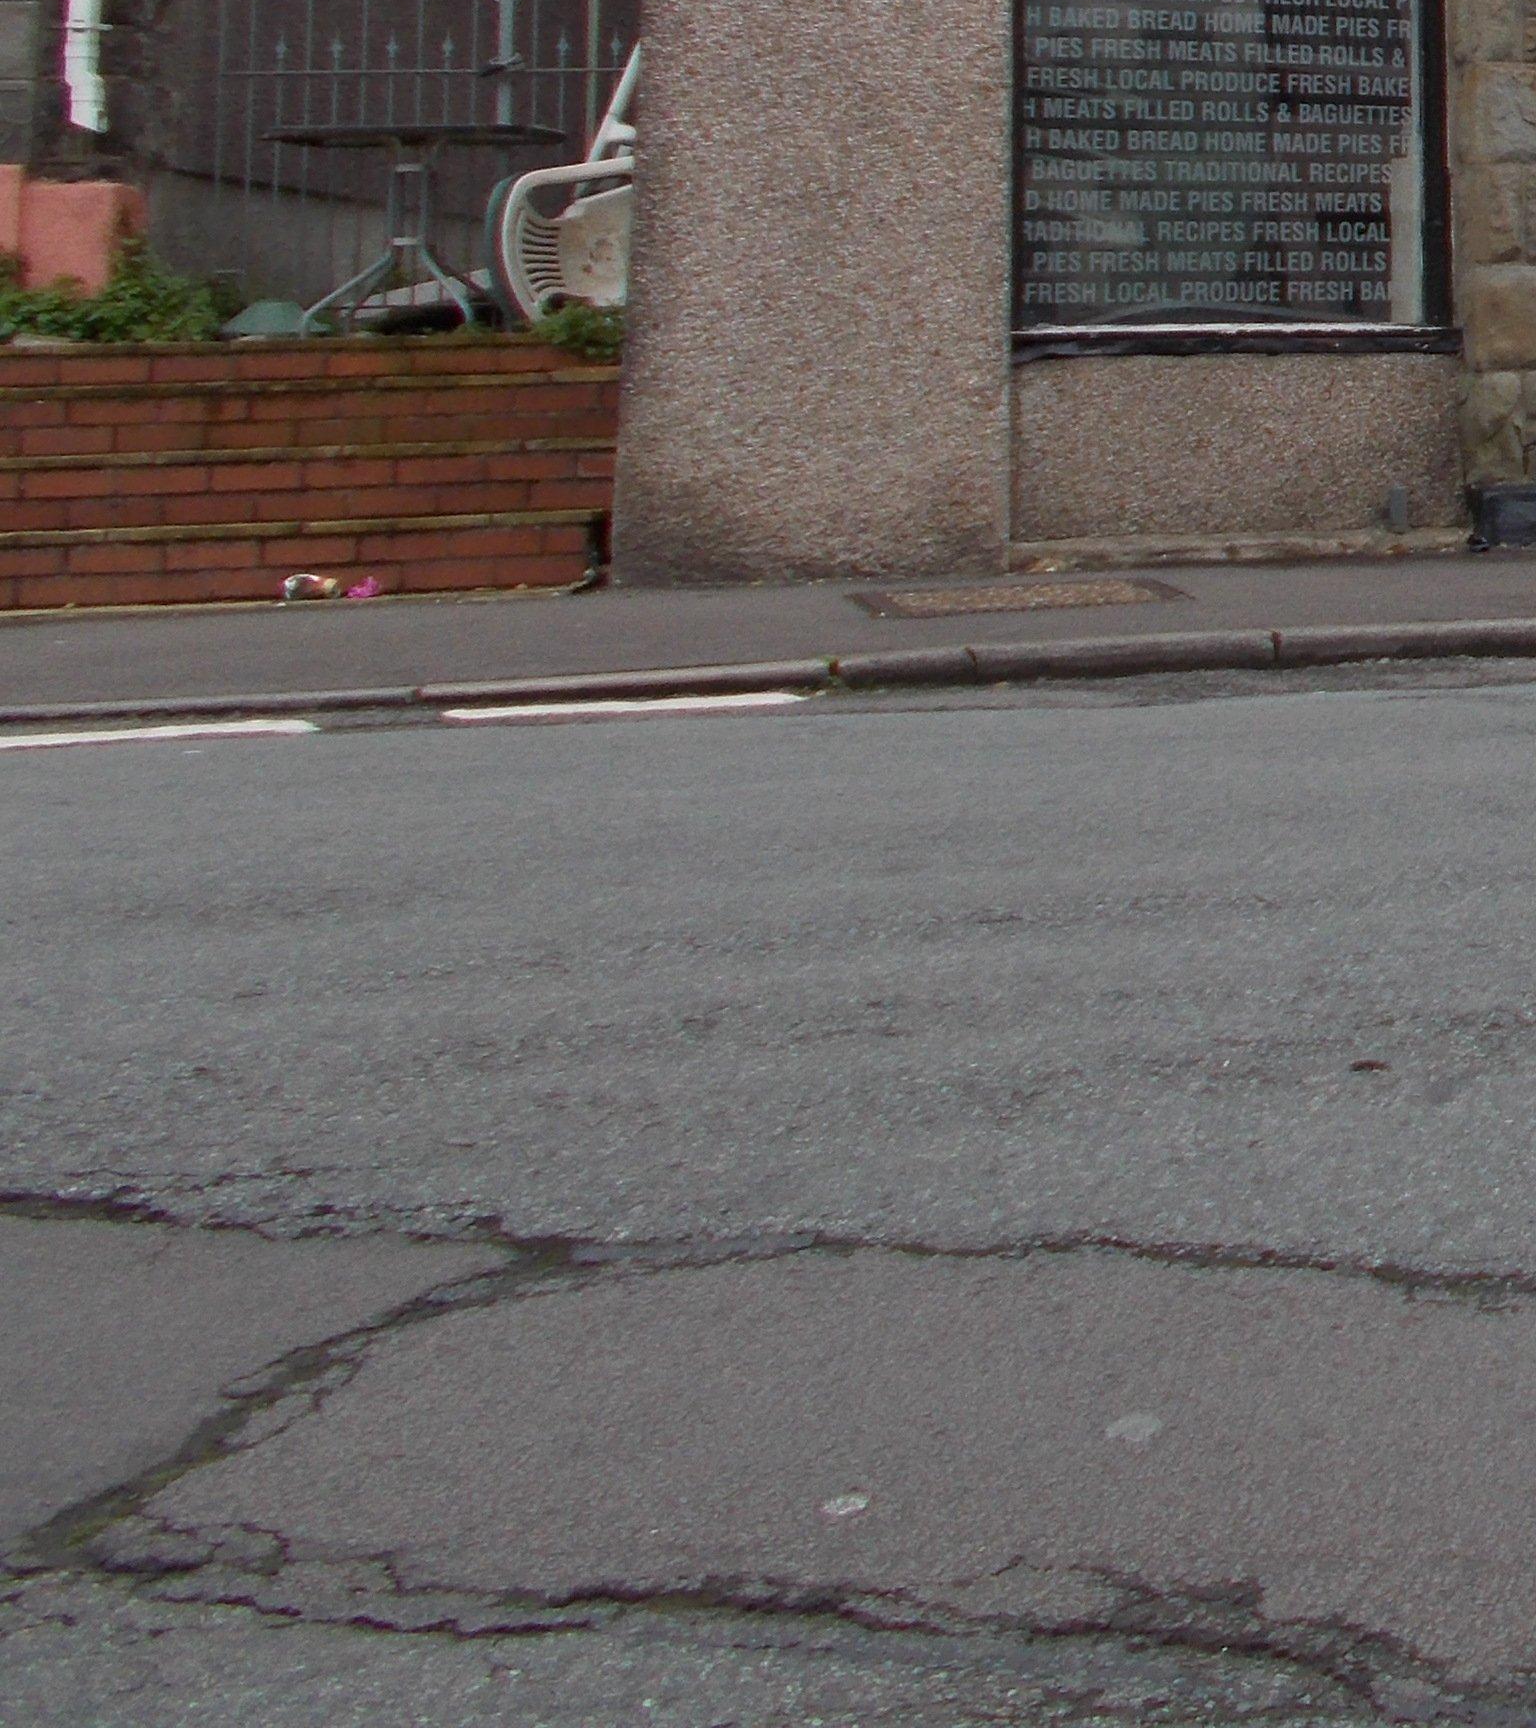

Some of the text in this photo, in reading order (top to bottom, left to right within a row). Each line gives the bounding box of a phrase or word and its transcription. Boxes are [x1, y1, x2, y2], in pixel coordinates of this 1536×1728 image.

[1050, 6, 1119, 29] BAKED
[1128, 8, 1197, 31] BREAD
[1204, 11, 1266, 34] HOME
[1271, 14, 1329, 36] MADE
[1335, 16, 1380, 39] PIES
[1035, 37, 1405, 69] PIES FRESH MEATS FILLED ROLLS &
[1026, 66, 1099, 89] FRESH
[1105, 68, 1175, 91] LOCAL
[1181, 70, 1281, 94] PRODUCE
[1287, 73, 1351, 96] FRESH
[1043, 98, 1116, 120] MEATS
[1124, 99, 1195, 121] FILLED
[1202, 100, 1269, 123] ROLLS
[1277, 102, 1291, 123] &
[1300, 103, 1413, 126] BAGUETTES
[1050, 128, 1121, 151] BAKED
[1127, 129, 1198, 152] BREAD
[1205, 131, 1267, 153] HOME
[1273, 132, 1332, 154] MADE
[1338, 133, 1383, 155] PIES
[1032, 158, 1392, 184] BAGUETTES TRADITIONAL RECIPES
[1049, 190, 1113, 212] HOME
[1119, 190, 1181, 212] MADE
[1187, 191, 1234, 212] PIES
[1241, 191, 1309, 213] FRESH
[1314, 192, 1383, 213] MEATS
[1158, 221, 1246, 243] RECIPES
[1253, 221, 1320, 243] FRESH
[1326, 221, 1391, 243] LOCAL
[1033, 250, 1387, 273] PIES FRESH MEATS FILLED ROLLS
[1024, 282, 1096, 305] FRESH
[1103, 281, 1173, 305] LOCAL
[1180, 280, 1281, 303] PRODUCE
[1287, 280, 1354, 302] FRESH
